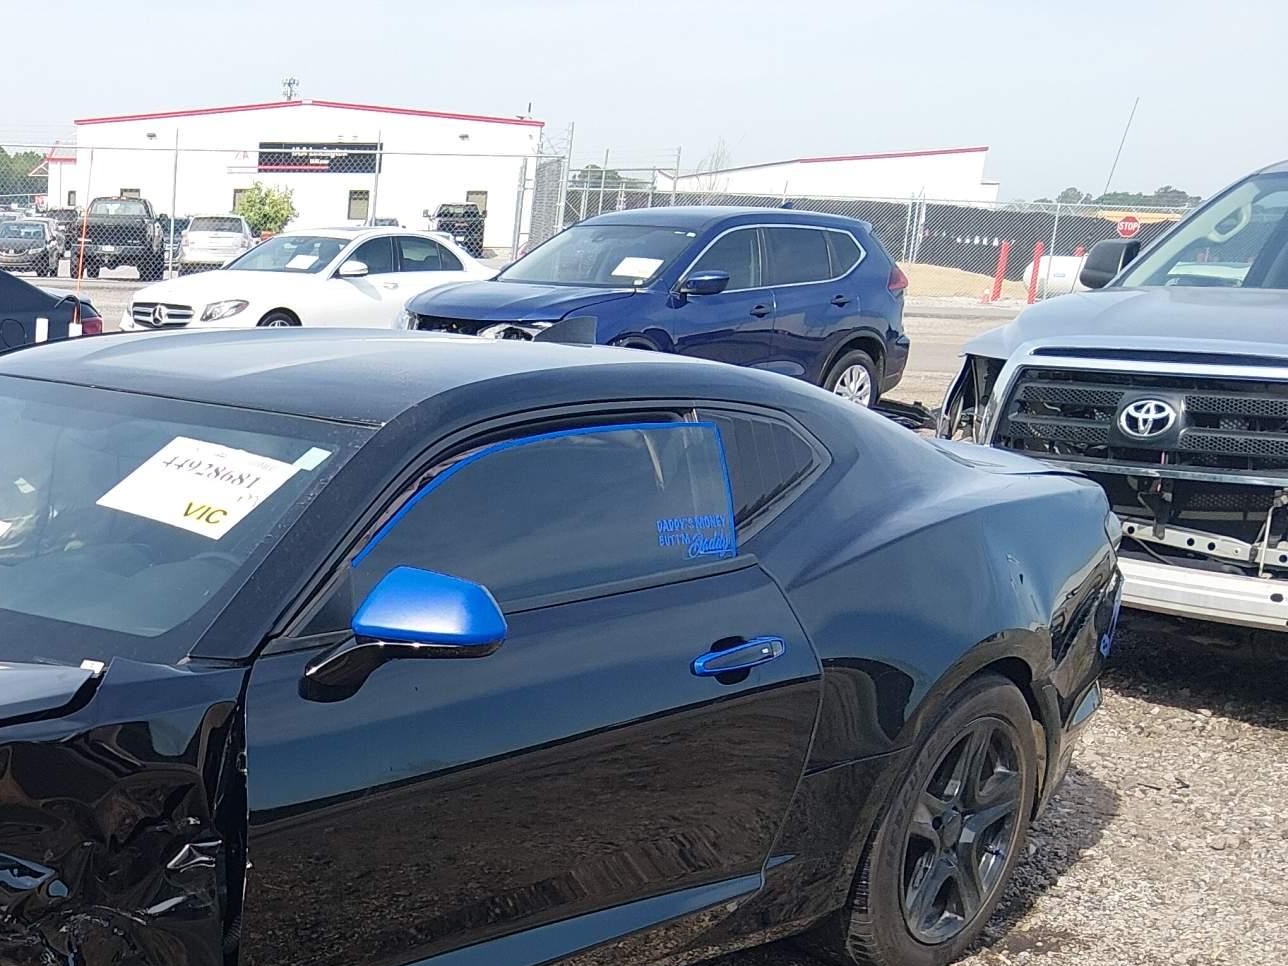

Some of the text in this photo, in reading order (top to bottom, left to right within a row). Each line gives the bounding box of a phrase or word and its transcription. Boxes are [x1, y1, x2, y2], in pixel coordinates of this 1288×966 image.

[1118, 221, 1139, 231] STOP
[161, 455, 261, 489] 44928681
[183, 501, 228, 525] VIC
